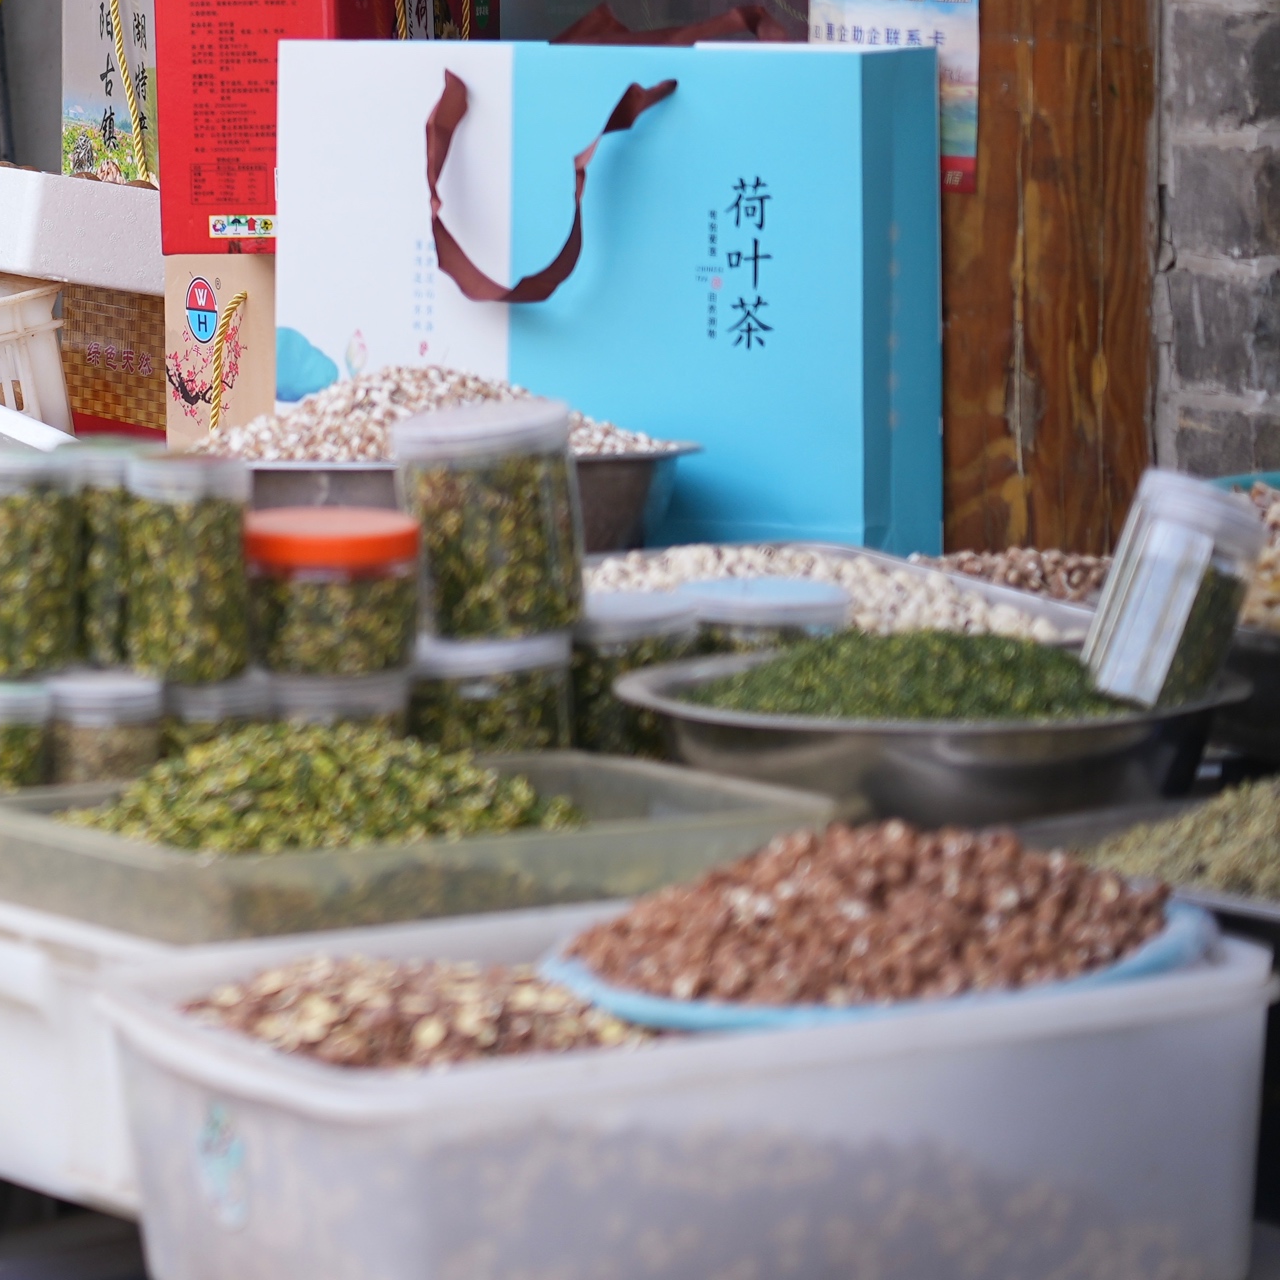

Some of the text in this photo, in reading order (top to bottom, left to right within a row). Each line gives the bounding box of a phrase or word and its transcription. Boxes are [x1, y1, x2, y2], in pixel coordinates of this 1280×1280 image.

[724, 175, 774, 351] 荷叶茶
[194, 288, 208, 307] W
[197, 314, 207, 333] H
[86, 341, 153, 377] 绿色天然
